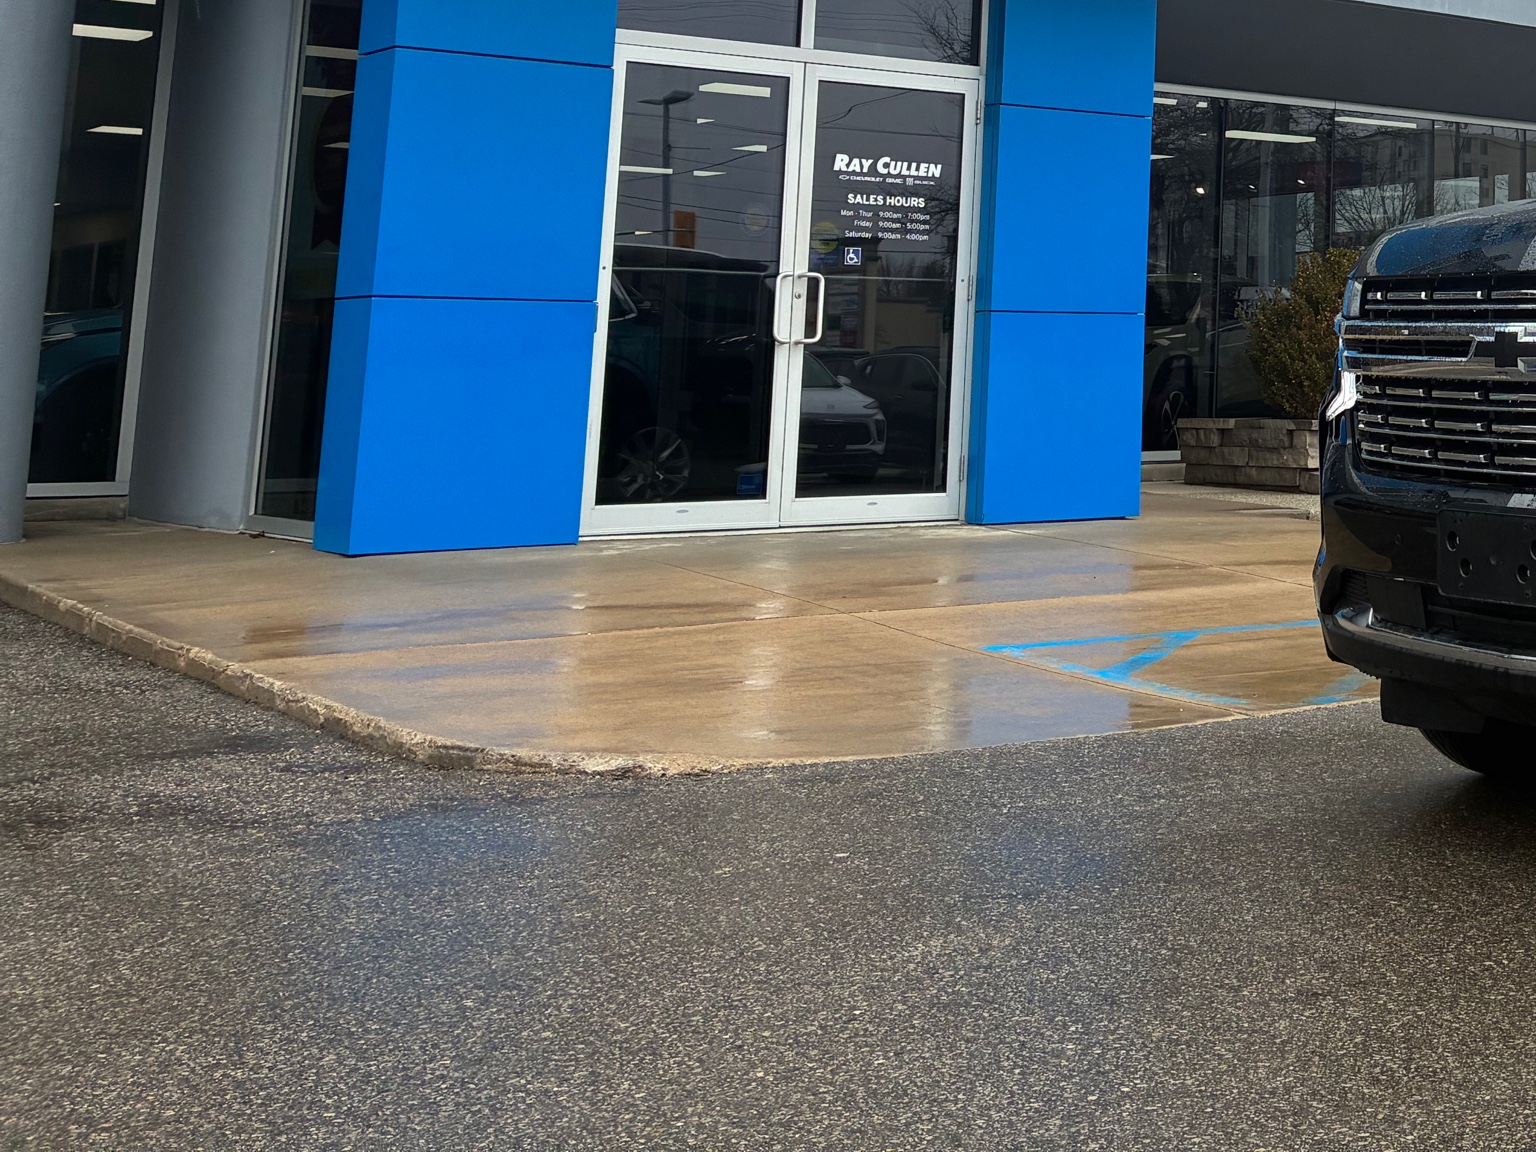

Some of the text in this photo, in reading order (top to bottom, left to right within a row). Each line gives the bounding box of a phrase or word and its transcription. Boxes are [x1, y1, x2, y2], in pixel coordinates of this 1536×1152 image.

[833, 153, 942, 178] RAY CULLEN
[847, 193, 926, 208] SALES HOURS
[840, 209, 854, 217] Mon
[859, 209, 873, 218] Thur
[878, 211, 902, 219] 9:00am
[907, 212, 930, 221] 7:00pm
[854, 219, 873, 228] Friday
[878, 221, 902, 229] 9:00am
[906, 222, 930, 231] 5:00pm
[844, 230, 873, 240] Saturday
[877, 232, 901, 240] 9:00am
[905, 233, 929, 241] 4:00pm
